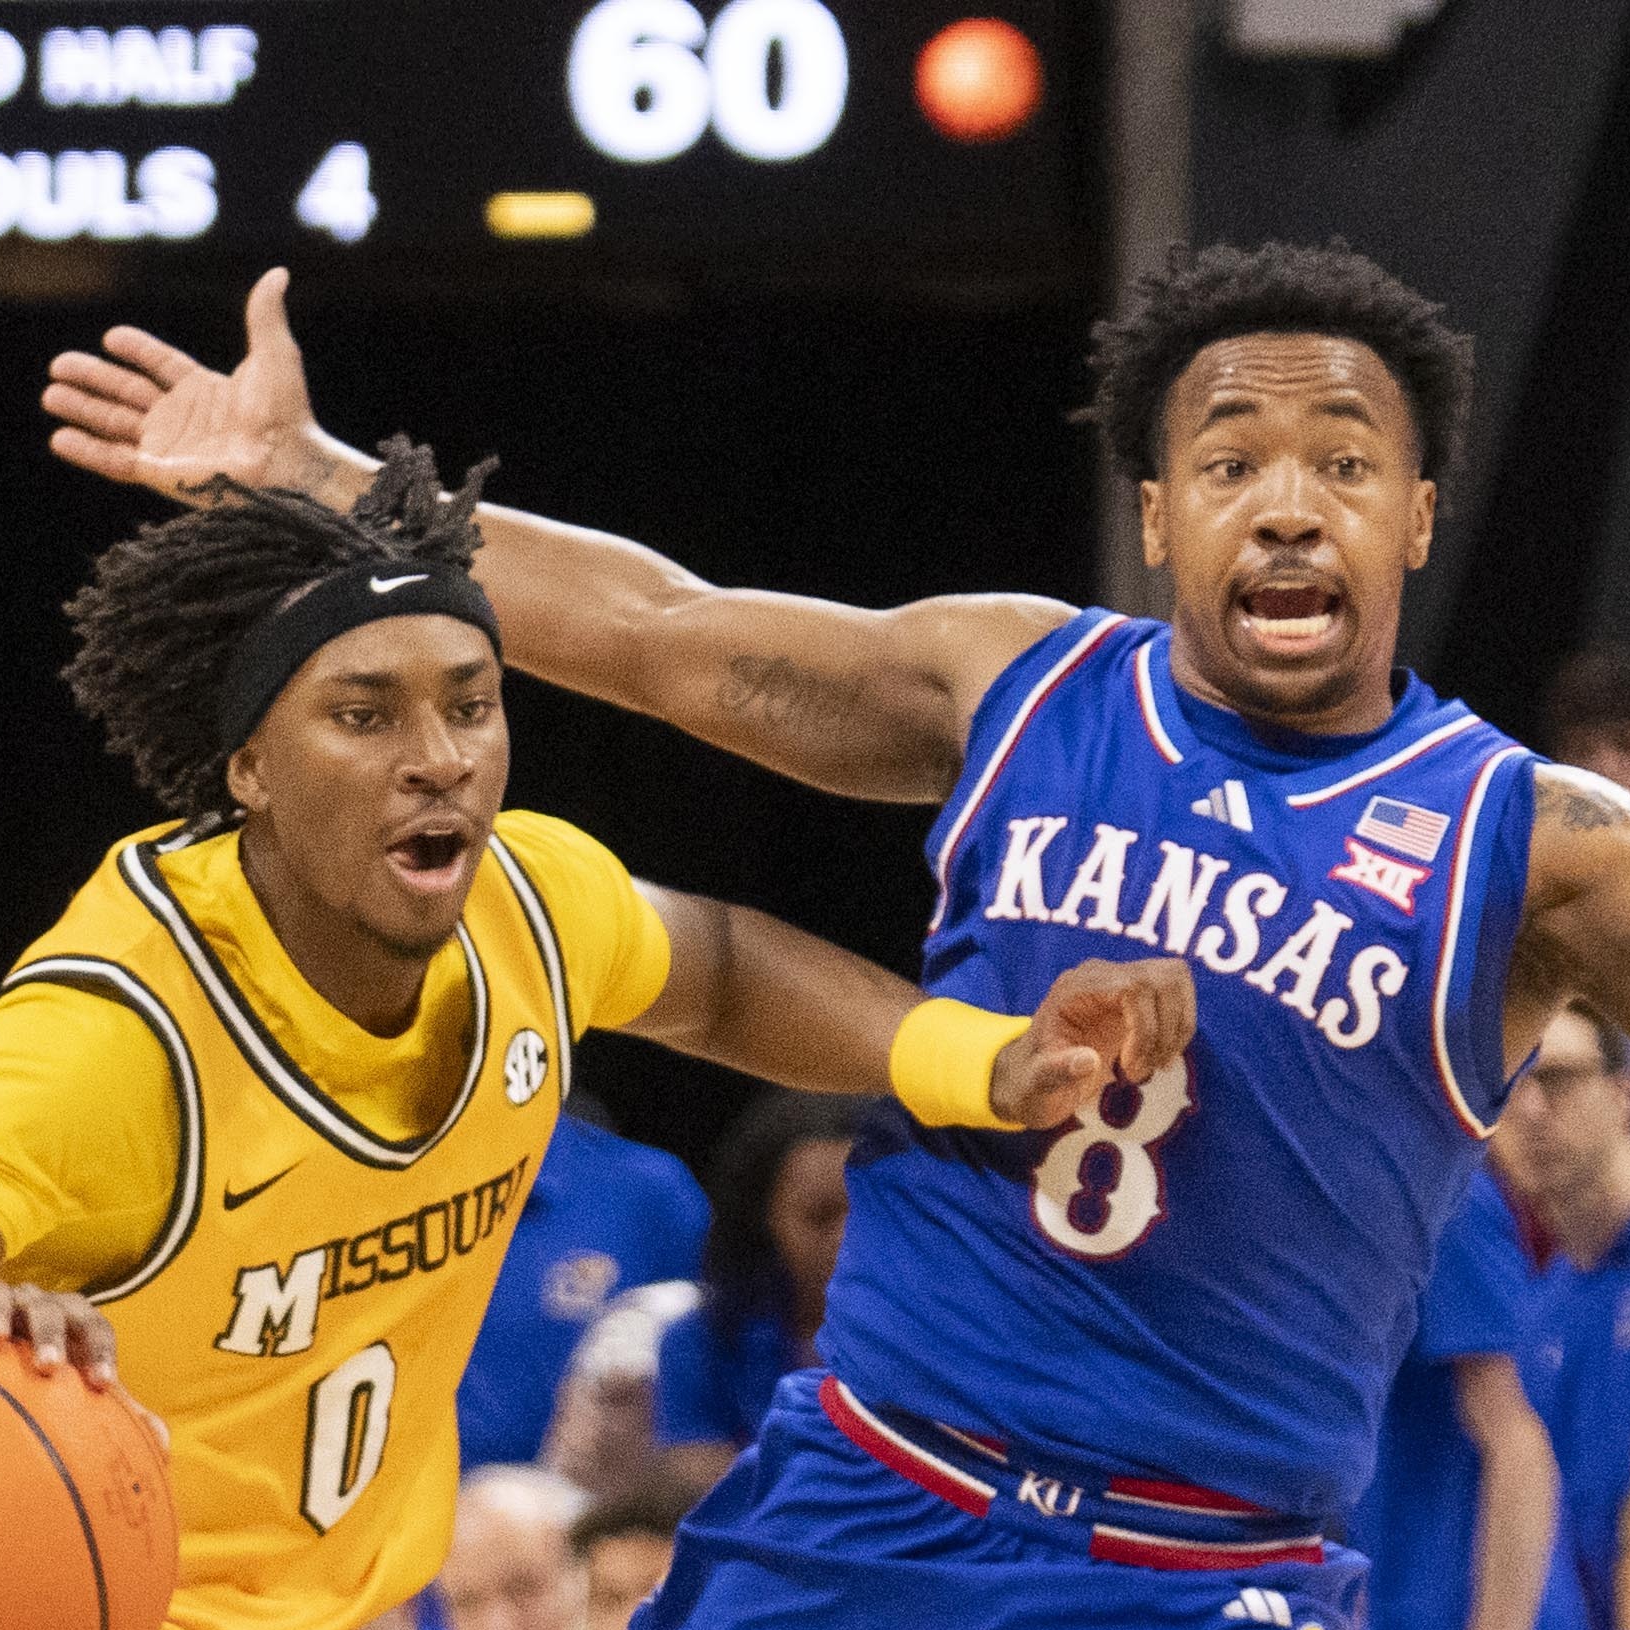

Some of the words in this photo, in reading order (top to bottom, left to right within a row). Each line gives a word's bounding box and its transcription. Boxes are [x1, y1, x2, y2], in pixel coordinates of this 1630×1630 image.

[40, 25, 259, 109] HALF
[571, 0, 849, 162] 60
[295, 140, 380, 244] 4
[985, 815, 1408, 1050] KANSAS
[503, 1027, 548, 1107] SEC
[1029, 1045, 1196, 1260] 8
[213, 1153, 531, 1358] MISSOURI
[301, 1340, 396, 1536] 0
[1016, 1470, 1085, 1518] KU
